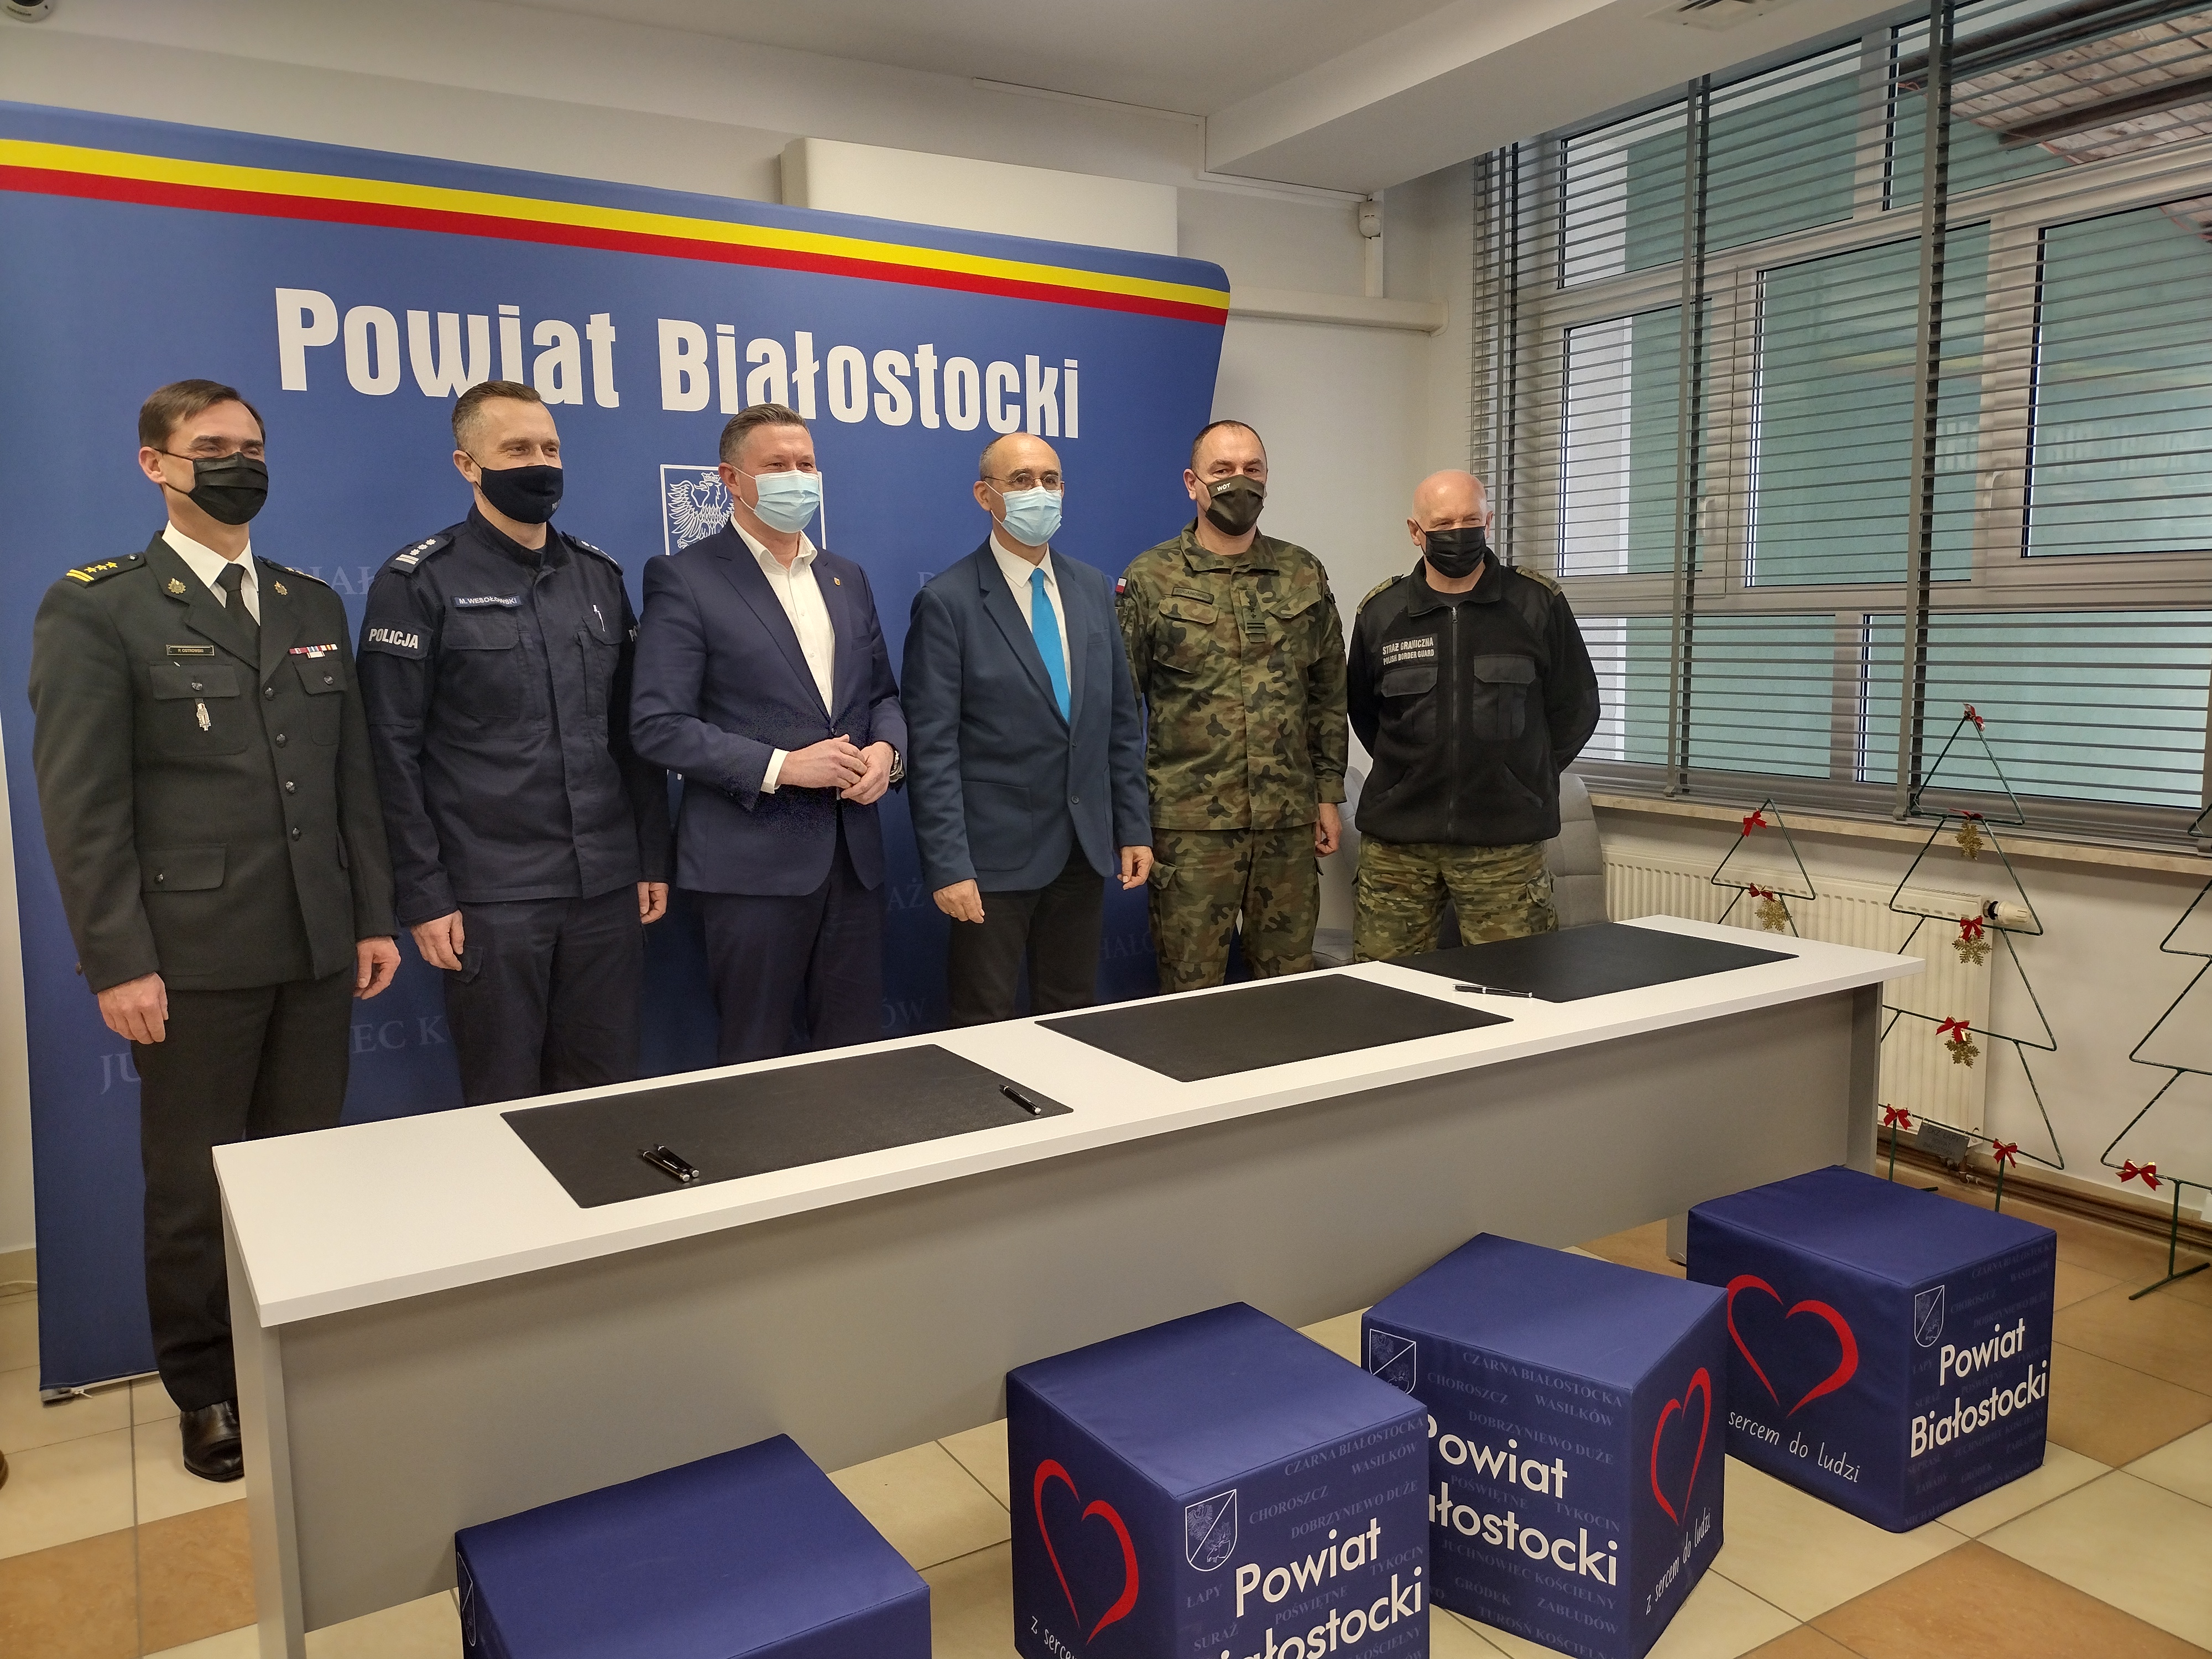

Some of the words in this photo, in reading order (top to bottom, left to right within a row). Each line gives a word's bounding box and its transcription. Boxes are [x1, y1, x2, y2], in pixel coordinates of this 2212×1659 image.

[276, 288, 619, 408] Powiat
[658, 319, 1078, 438] Białostocki
[1217, 482, 1231, 492] WOT
[468, 596, 517, 604] WESOŁOWSKI
[368, 628, 419, 649] POLICJA
[1383, 643, 1399, 655] STRAŻ
[1400, 637, 1434, 650] GRANICZNA
[1383, 654, 1397, 665] POLISH
[1398, 651, 1417, 661] BORDER
[1417, 649, 1434, 658] GUARD
[1940, 1318, 2025, 1386] Powiat
[1427, 1371, 1509, 1406] CHOROSZCZ
[1463, 1351, 1518, 1378] CZARNA
[1521, 1368, 1623, 1408] BIAŁOSTOCKA
[1535, 1394, 1614, 1427] WASILKÓW
[1911, 1360, 2047, 1458] Białostocki
[1284, 1449, 1336, 1477] CZARNA
[1339, 1417, 1425, 1457] BIAŁOSTOCKA
[1468, 1410, 1572, 1452] DOBRZYNIEWO
[1575, 1442, 1614, 1465] DUŻE
[1729, 1411, 1780, 1446] sercem
[1789, 1431, 1808, 1458] do
[1818, 1442, 1860, 1483] ludzi
[1352, 1441, 1418, 1475] WASILKÓW
[1249, 1485, 1329, 1525] CHOROSZCZ
[1291, 1494, 1384, 1540] DOBRZYNIEWO
[1386, 1480, 1418, 1502] DUŻE
[1554, 1501, 1620, 1533] TYKOCIN
[1428, 1481, 1618, 1587] łostocki
[1235, 1517, 1381, 1618] Powiat
[1369, 1544, 1425, 1576] TYKOCIN
[1646, 1594, 1652, 1615] z
[1655, 1556, 1679, 1602] sercem
[1683, 1531, 1692, 1564] do
[1694, 1506, 1711, 1548] ludzi
[1187, 1584, 1223, 1609] ŁAPY
[1275, 1585, 1349, 1625] POŚWIĘTNE
[1535, 1571, 1617, 1610] KOŚCIELNY
[1031, 1615, 1038, 1634] z
[1193, 1622, 1239, 1652] SURAŻ
